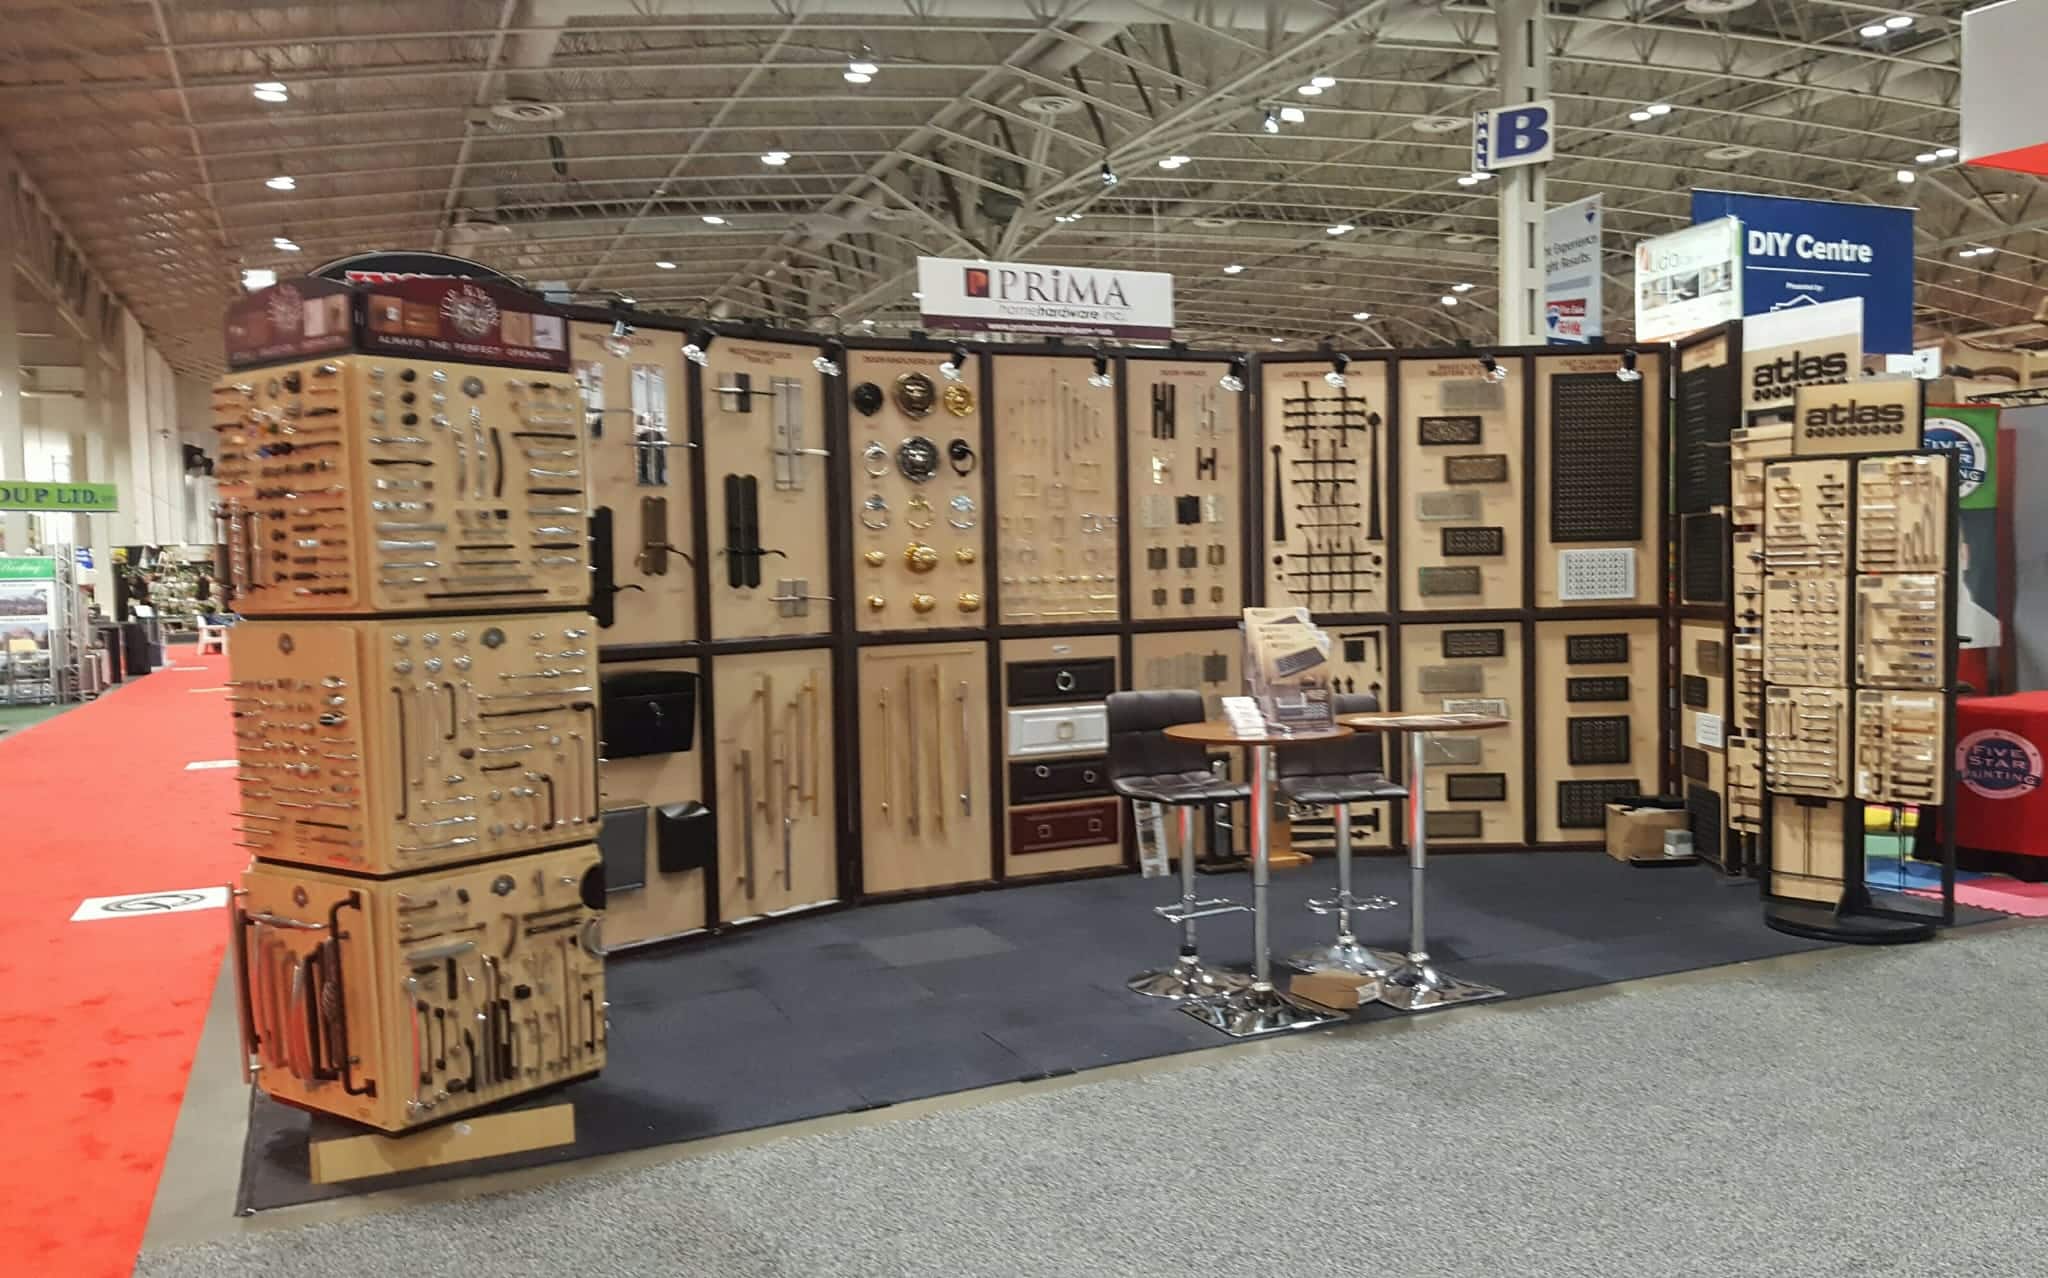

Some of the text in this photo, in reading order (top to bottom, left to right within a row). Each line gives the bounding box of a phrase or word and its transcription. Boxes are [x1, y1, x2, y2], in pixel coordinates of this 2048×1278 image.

[1497, 107, 1549, 160] B
[1747, 229, 1874, 263] DIY Centre
[1753, 350, 1849, 388] atlas
[1805, 398, 1905, 427] atlas
[1923, 438, 1968, 451] FIVE
[56, 488, 99, 505] LTD.
[1968, 755, 2027, 770] STAR
[1973, 745, 2025, 759] FIVE
